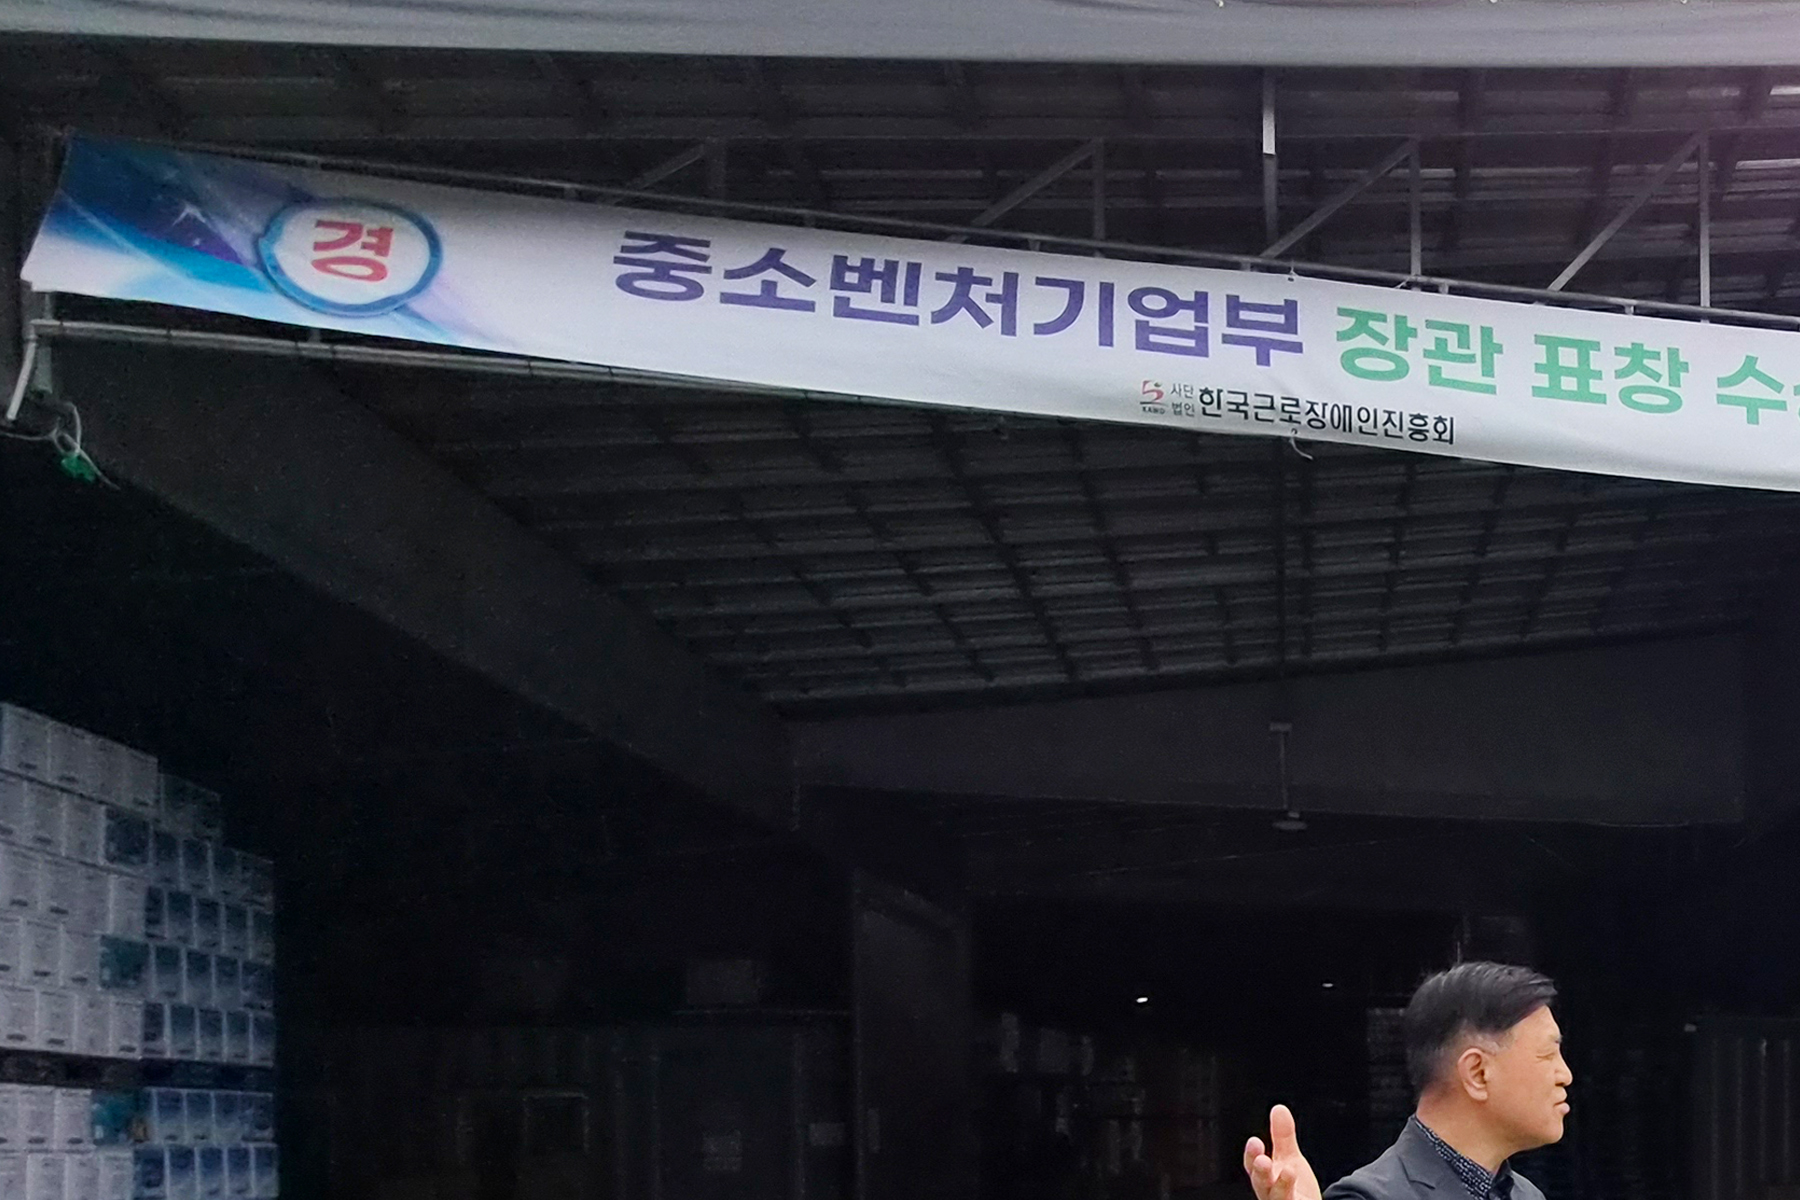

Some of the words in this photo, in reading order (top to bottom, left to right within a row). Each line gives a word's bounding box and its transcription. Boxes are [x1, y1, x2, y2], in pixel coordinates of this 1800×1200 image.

[311, 220, 394, 282] 경
[612, 230, 1303, 367] 중소벤처기업부
[1336, 306, 1504, 395] 장관
[1531, 333, 1690, 414] 표창
[1170, 383, 1195, 399] 사단
[1171, 402, 1195, 417] 법인
[1199, 387, 1455, 445] 한국근로장애인진흥회
